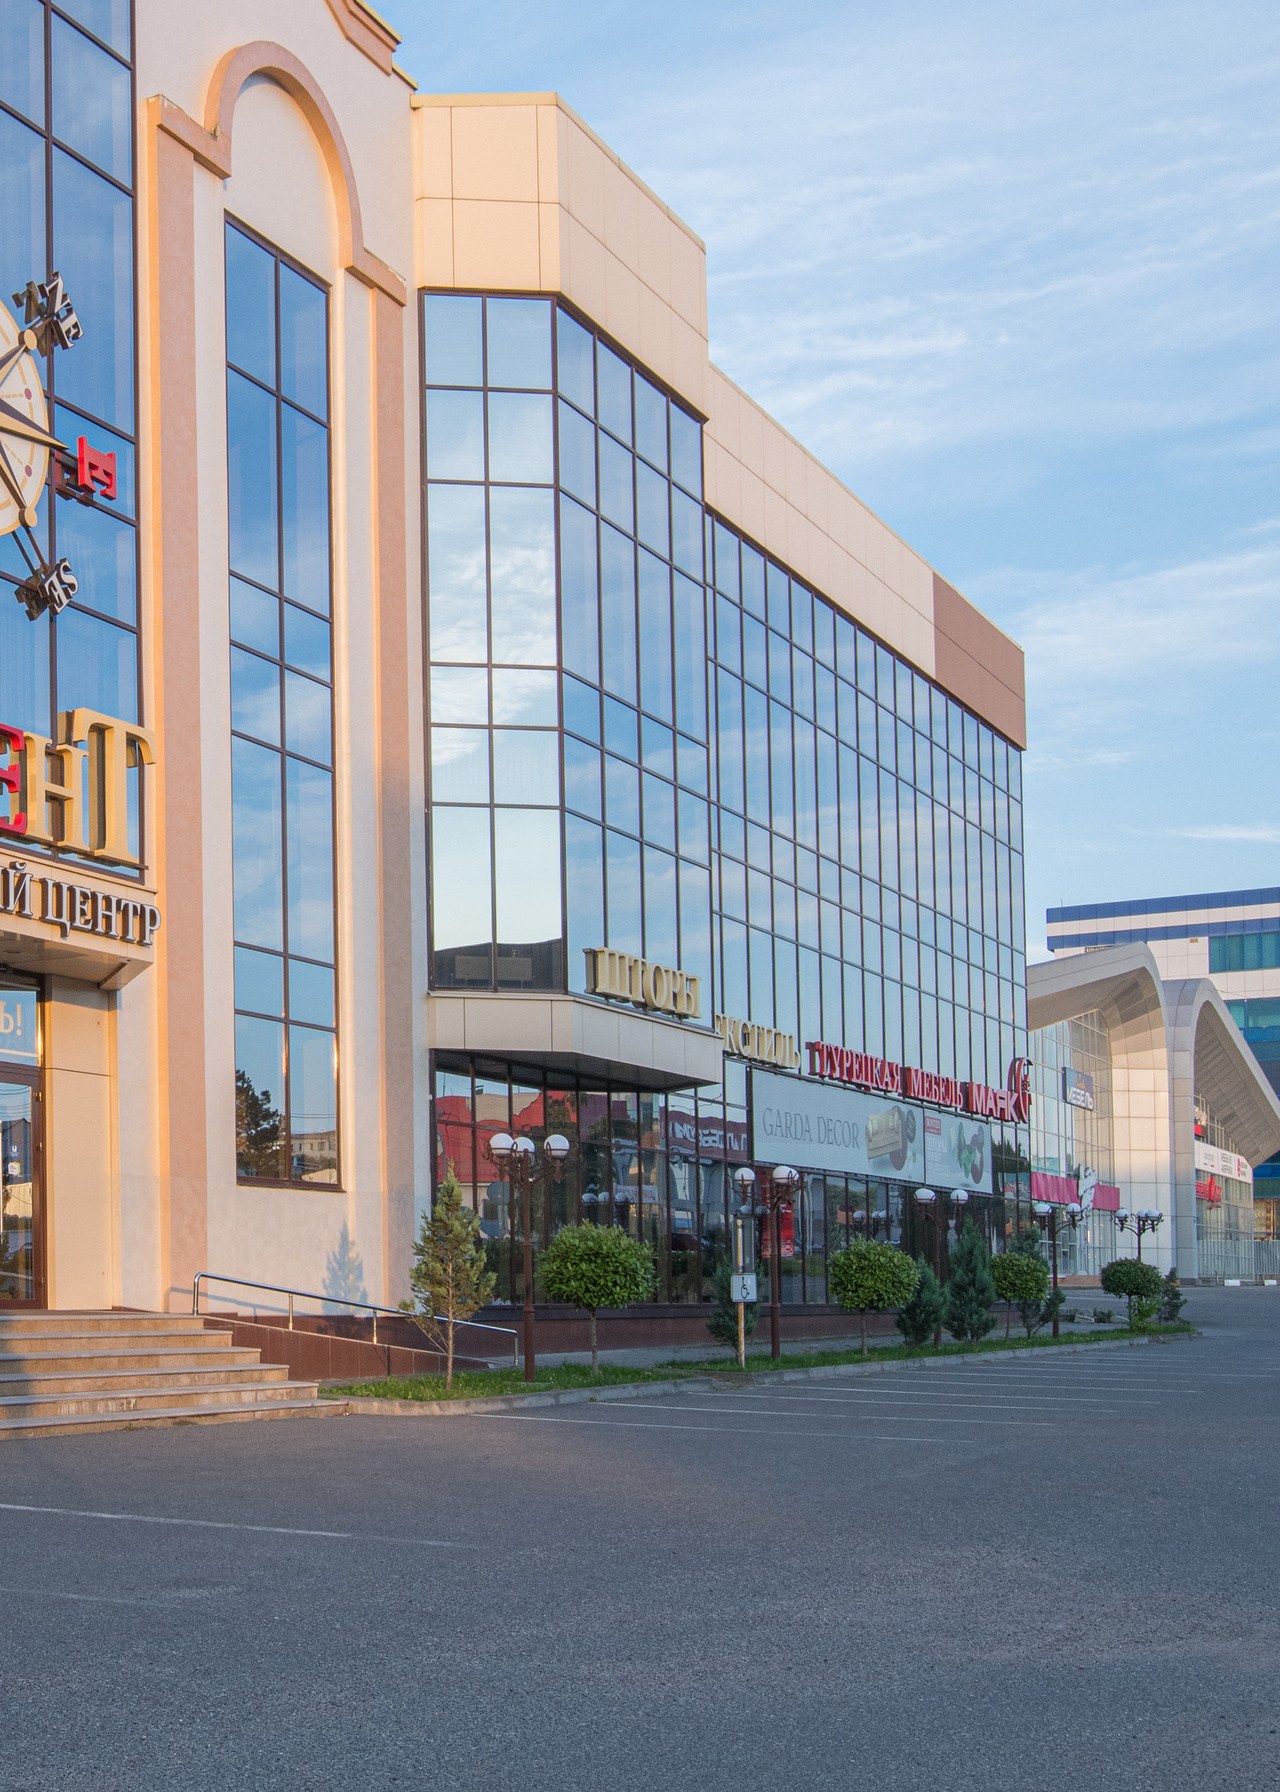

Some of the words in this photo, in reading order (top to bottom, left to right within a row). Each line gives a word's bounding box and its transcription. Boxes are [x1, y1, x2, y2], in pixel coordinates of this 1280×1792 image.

[42, 271, 82, 350] NE
[78, 436, 116, 500] E
[41, 878, 161, 946] ЦЕНТР
[592, 947, 702, 1019] ШТОРЫ
[816, 1041, 903, 1093] ТУРЕЦКАЯ
[909, 1067, 964, 1109] МЕБЕЛЬ
[762, 1107, 812, 1142] GARDA
[817, 1116, 860, 1149] DECOR
